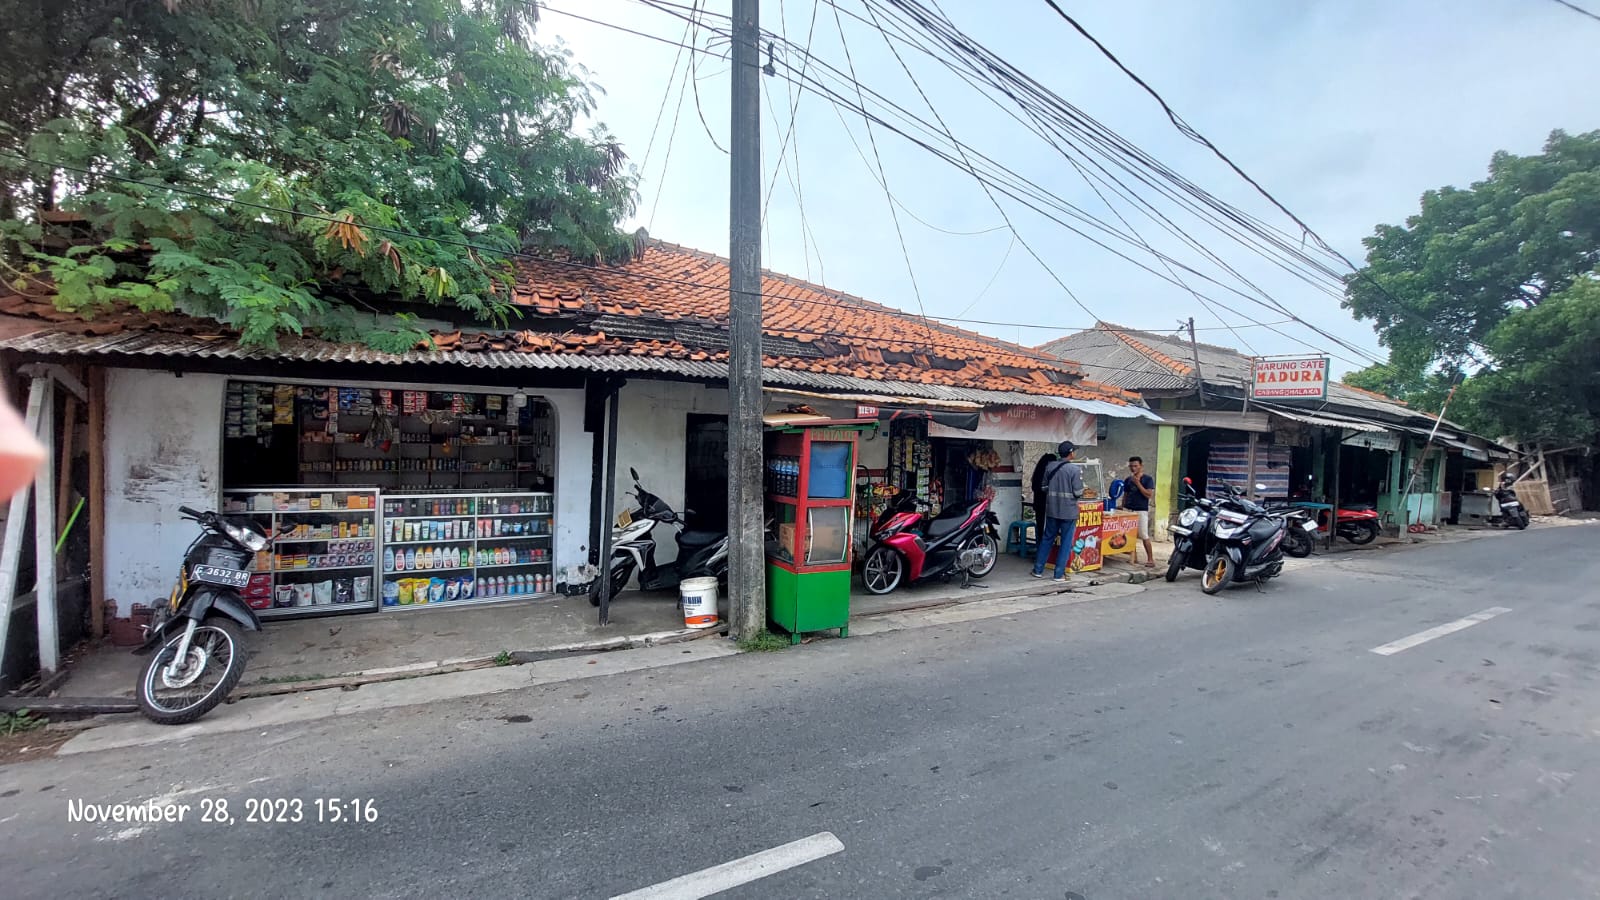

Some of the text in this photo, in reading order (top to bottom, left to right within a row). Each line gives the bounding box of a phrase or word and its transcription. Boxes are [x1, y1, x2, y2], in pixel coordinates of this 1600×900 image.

[1257, 360, 1324, 370] WARUNG SATE
[1257, 370, 1323, 383] MADURA
[207, 567, 232, 578] 3632
[235, 571, 249, 580] BR
